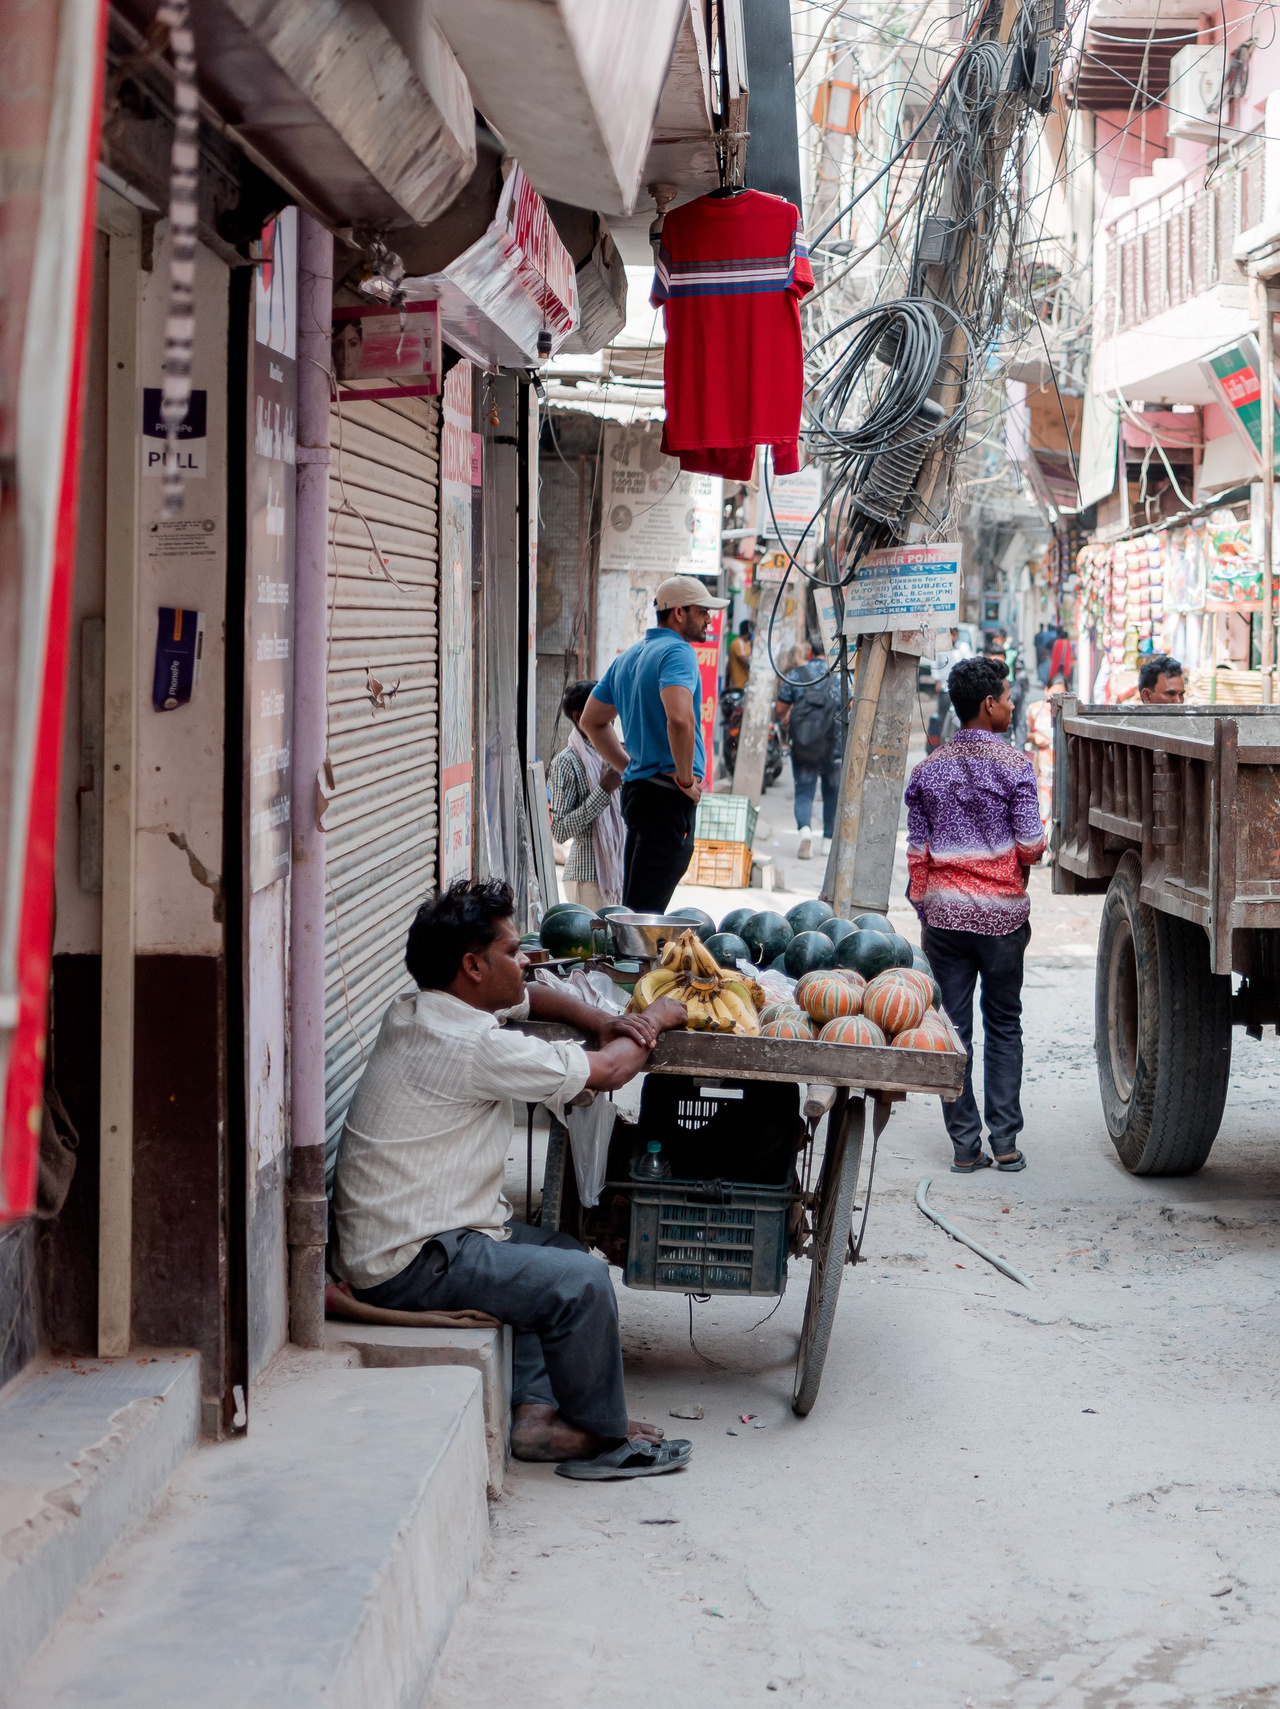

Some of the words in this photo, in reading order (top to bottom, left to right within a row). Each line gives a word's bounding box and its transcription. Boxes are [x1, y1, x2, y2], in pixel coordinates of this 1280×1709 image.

[155, 423, 193, 433] PhePe
[907, 553, 943, 564] POINT
[860, 578, 887, 587] Tuiton
[889, 577, 924, 585] Classes
[168, 660, 180, 696] PhonePe
